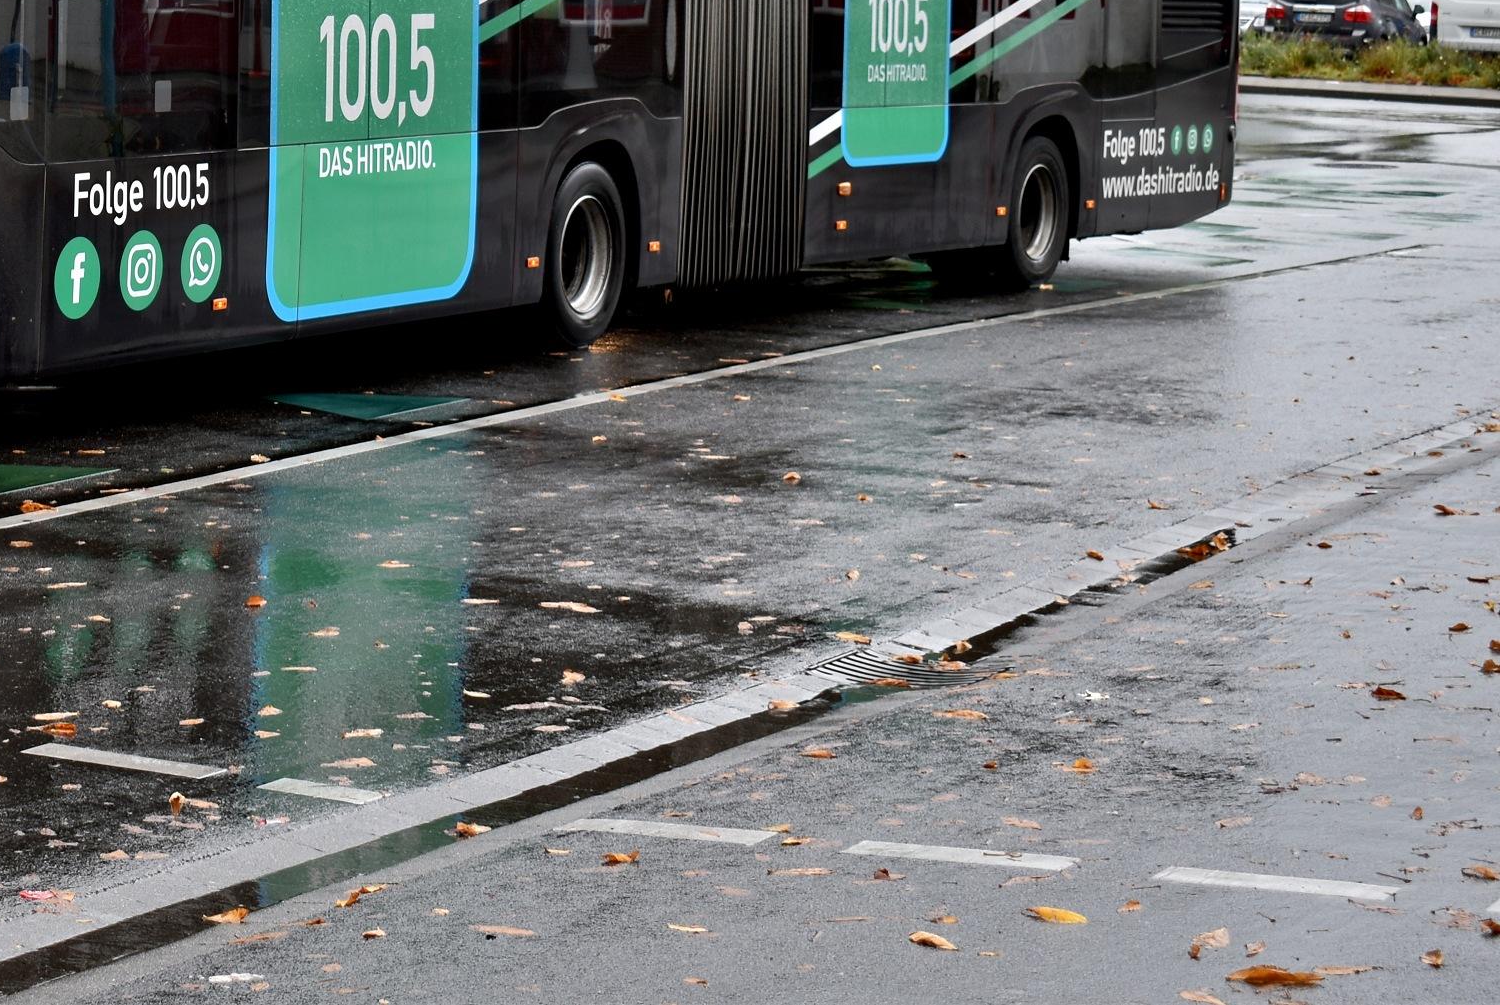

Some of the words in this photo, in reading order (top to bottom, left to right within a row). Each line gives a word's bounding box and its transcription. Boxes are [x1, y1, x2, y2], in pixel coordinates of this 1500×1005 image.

[319, 13, 435, 127] 100,5
[868, 64, 886, 82] DAS
[886, 64, 928, 81] HITRADIO.
[319, 145, 353, 178] DAS
[357, 139, 436, 175] HITRADIO.
[1103, 129, 1136, 164] Folge
[1139, 127, 1165, 156] 100,5
[73, 172, 144, 226] Folge
[153, 163, 210, 211] 100,5
[1102, 163, 1219, 199] www.dashitradio.de
